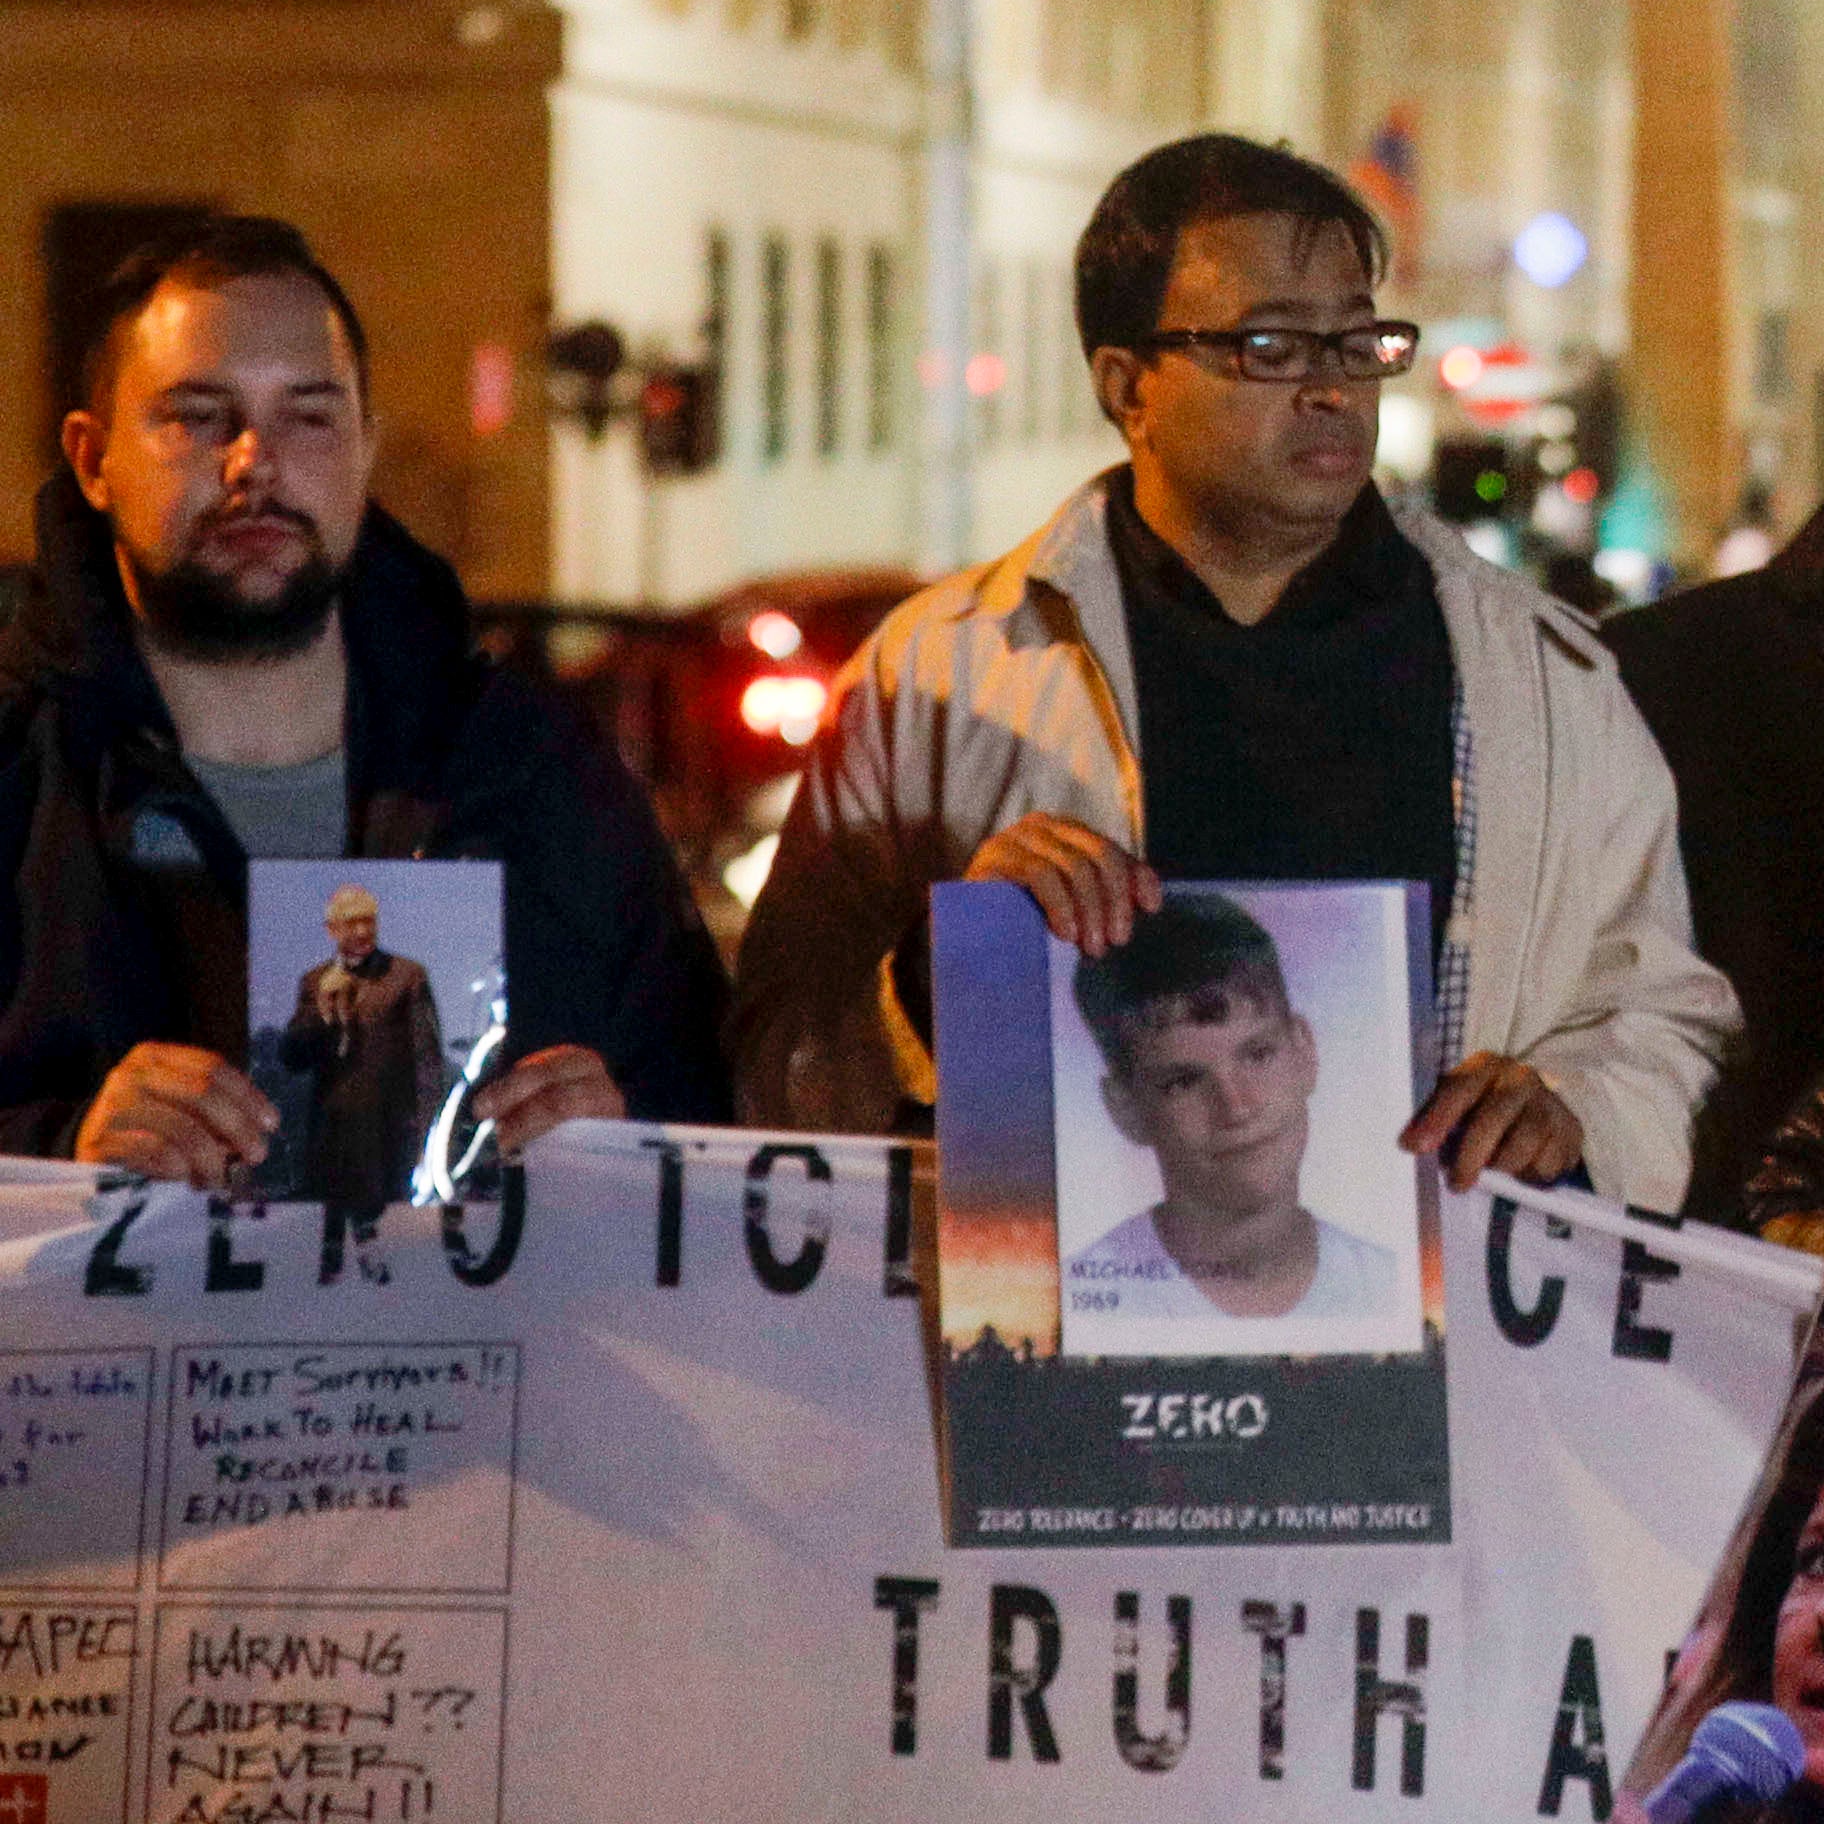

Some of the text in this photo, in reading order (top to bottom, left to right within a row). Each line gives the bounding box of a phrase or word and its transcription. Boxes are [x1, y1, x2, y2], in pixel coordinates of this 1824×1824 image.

[1070, 1259, 1171, 1281] MICHAEL
[1120, 1392, 1268, 1439] ZERO
[874, 1576, 1430, 1798] TRUTH
[168, 1742, 425, 1788] NEVER
